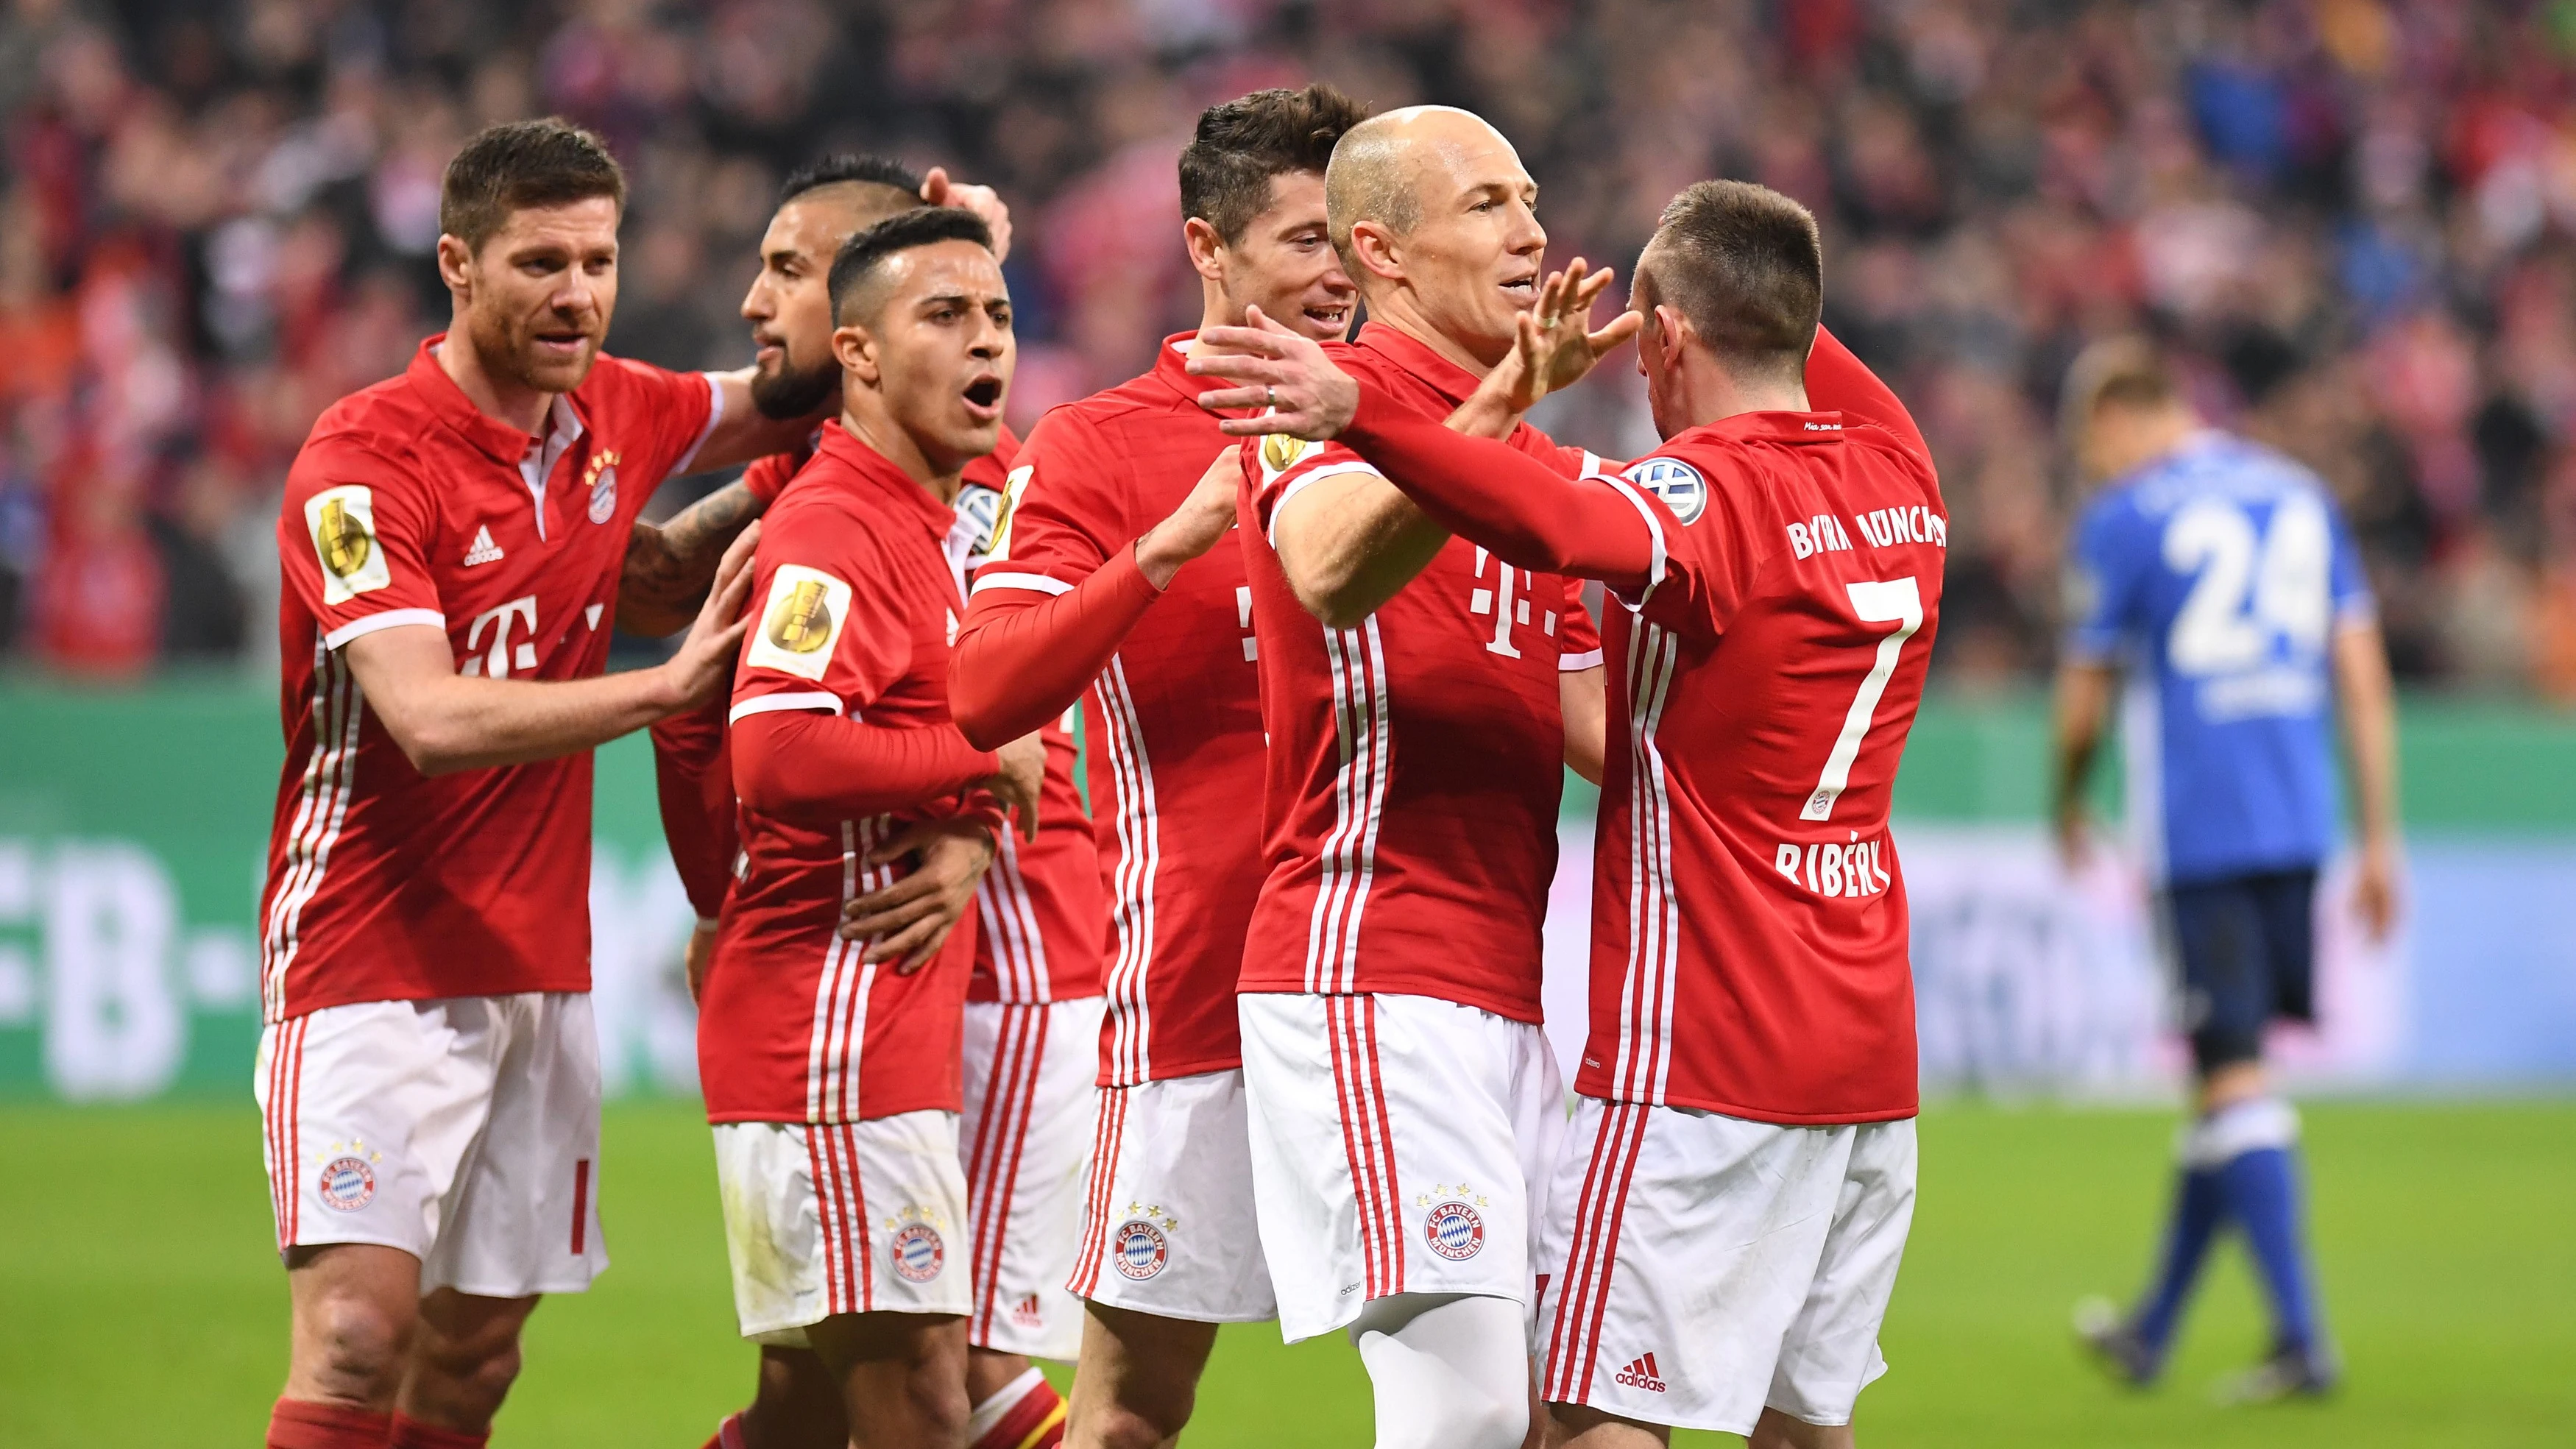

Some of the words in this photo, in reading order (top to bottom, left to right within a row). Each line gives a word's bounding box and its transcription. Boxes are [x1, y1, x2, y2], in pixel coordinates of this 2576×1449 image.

[2162, 495, 2333, 677] 24
[1798, 577, 1923, 821] 7
[1429, 1214, 1441, 1229] FC
[1439, 1205, 1481, 1228] BAYERN
[1117, 1230, 1130, 1244] FC
[1128, 1224, 1164, 1250] BAYERN
[1430, 1236, 1482, 1257] MÜNCHEN
[1615, 1372, 1666, 1393] adidas
